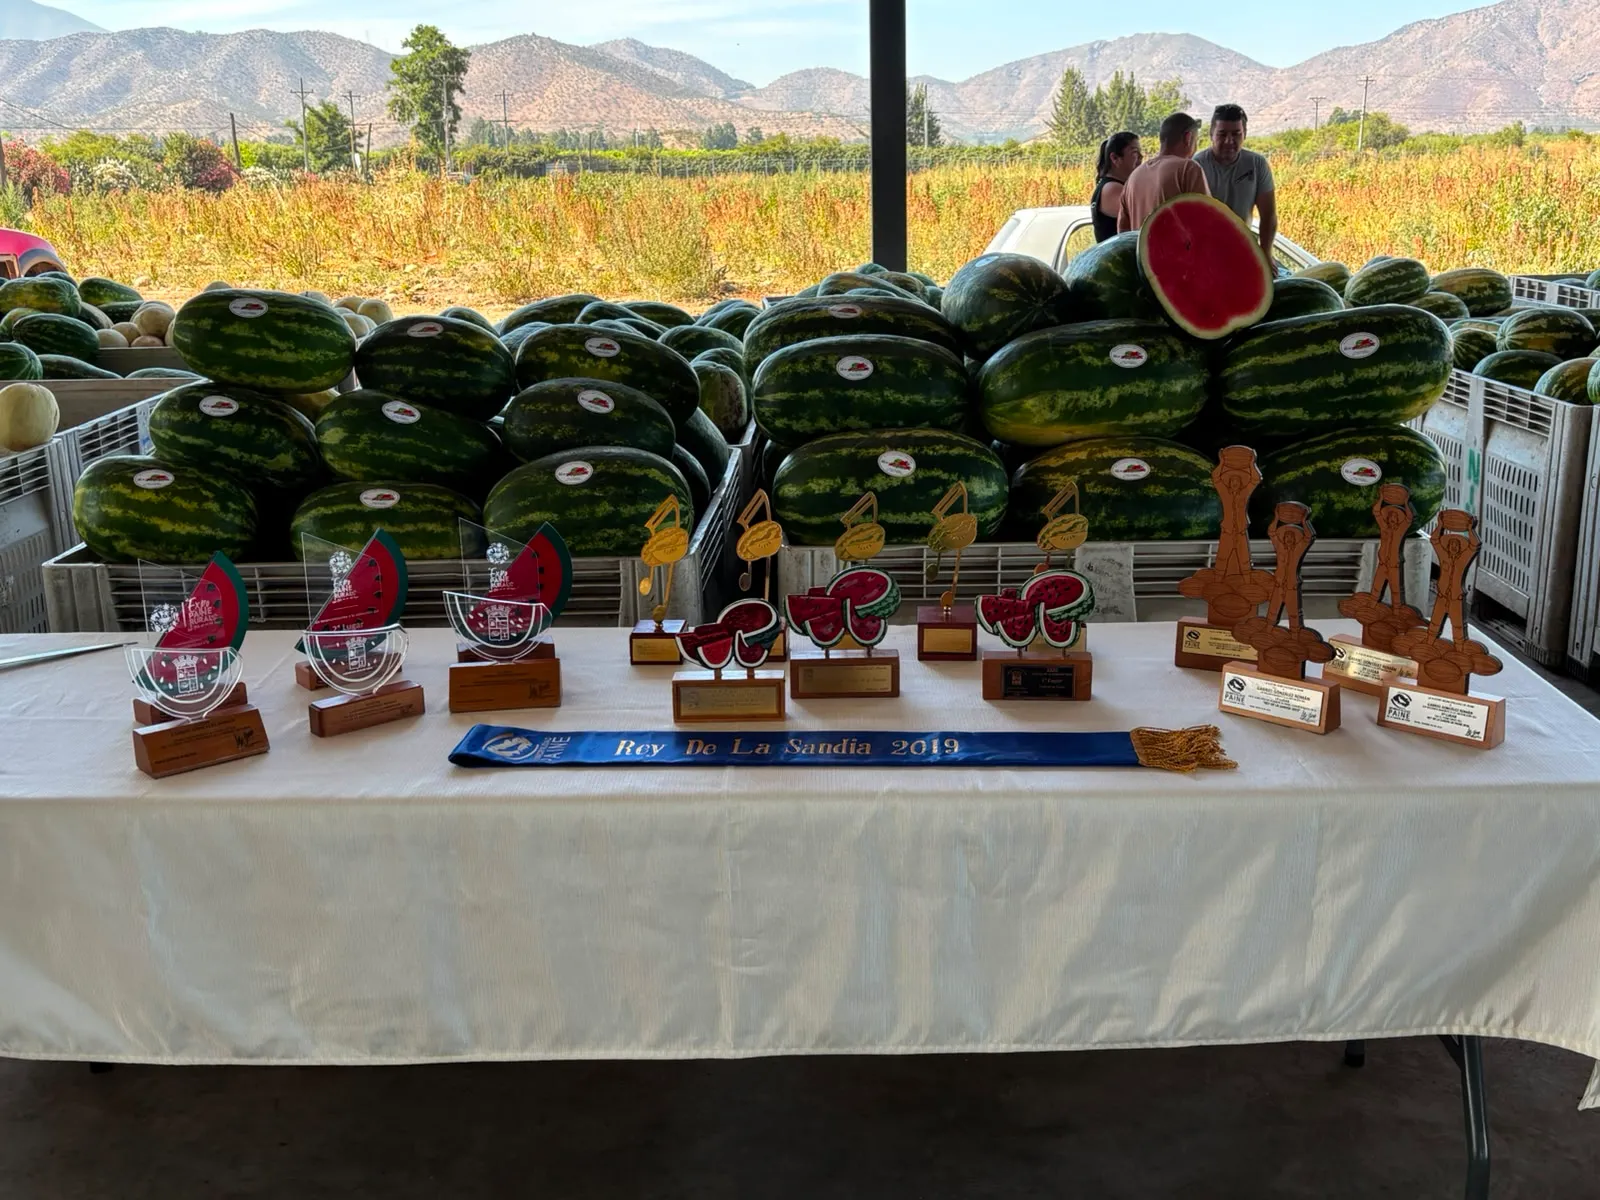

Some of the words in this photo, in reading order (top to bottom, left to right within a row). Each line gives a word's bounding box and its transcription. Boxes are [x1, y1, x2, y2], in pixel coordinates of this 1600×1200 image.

[1224, 693, 1246, 703] PAINE
[1388, 709, 1411, 719] PAINE
[614, 739, 668, 758] Rey
[685, 738, 718, 756] De
[731, 738, 771, 756] La
[891, 738, 960, 756] 2019
